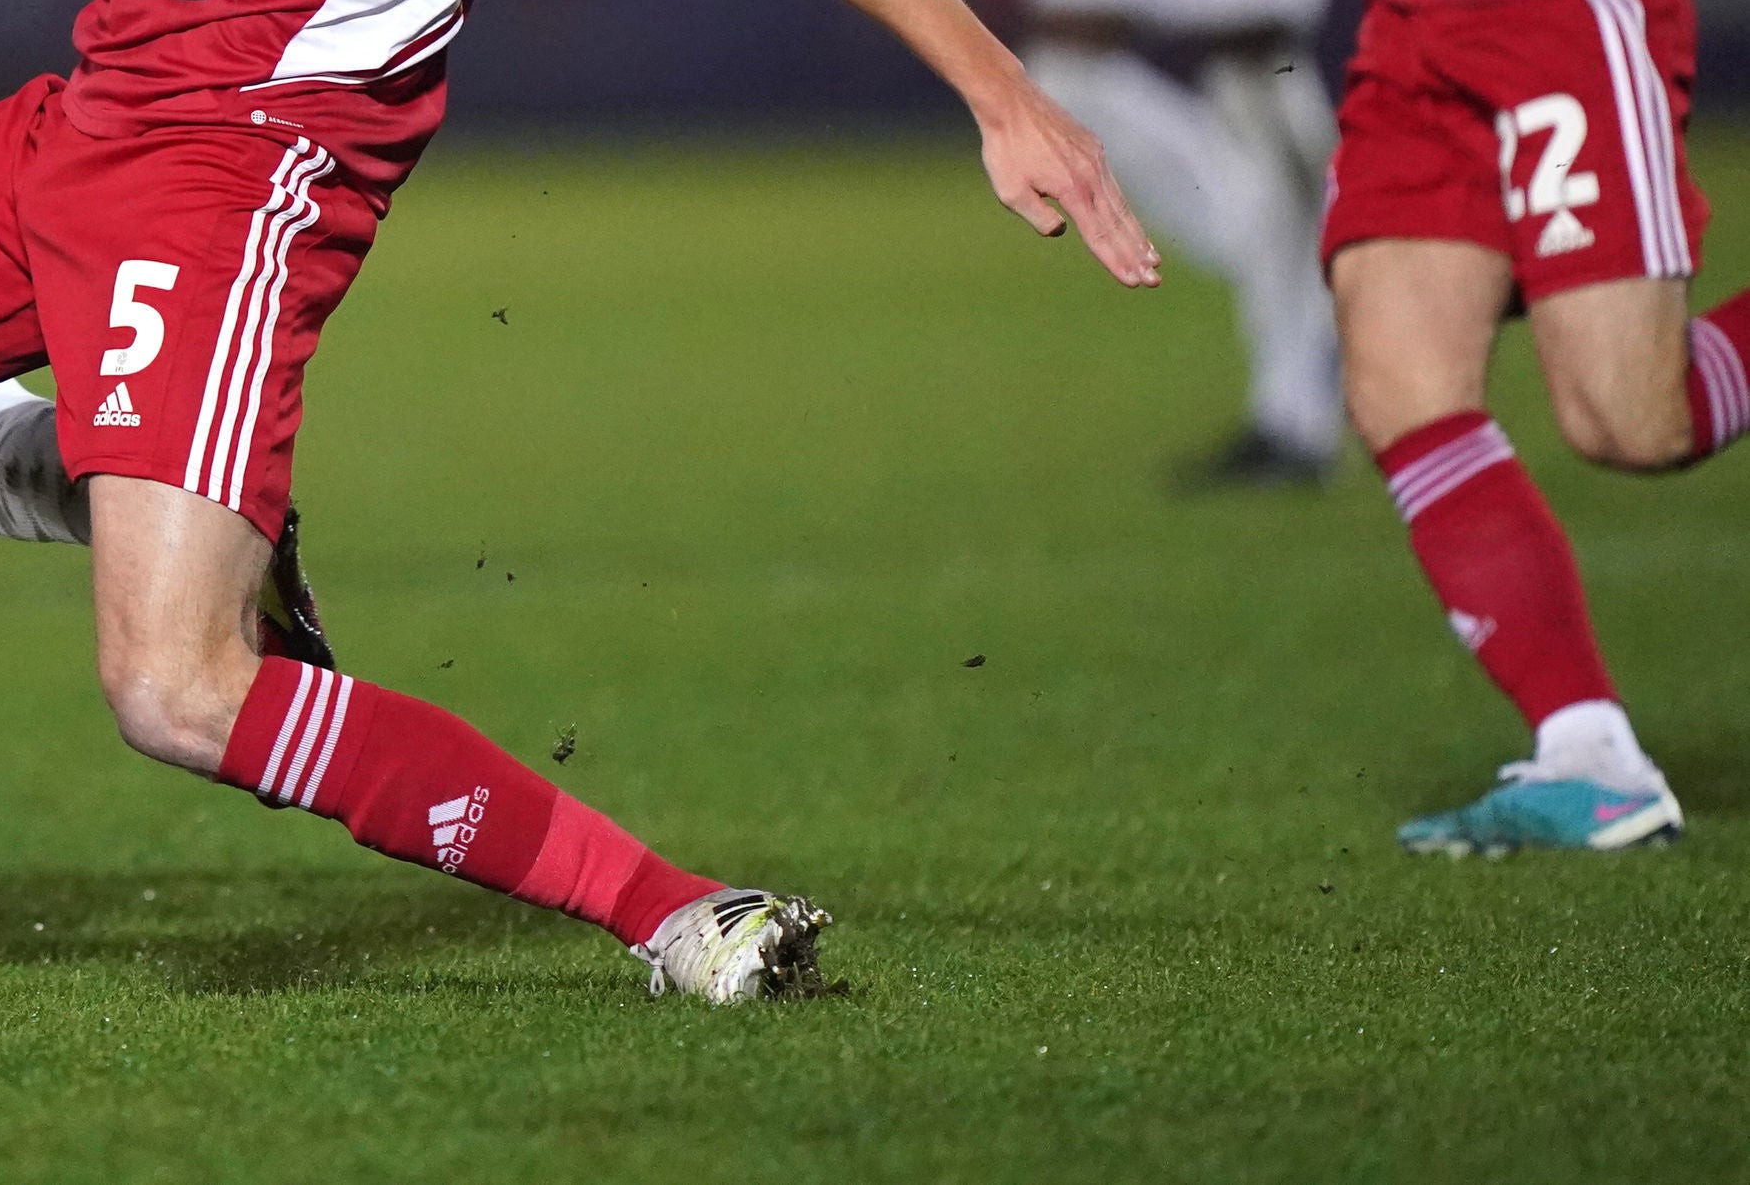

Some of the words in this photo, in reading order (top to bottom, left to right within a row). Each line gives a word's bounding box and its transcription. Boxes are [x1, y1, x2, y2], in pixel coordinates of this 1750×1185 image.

[99, 259, 181, 377] 5
[93, 409, 142, 427] adidas
[441, 785, 490, 874] adidas
